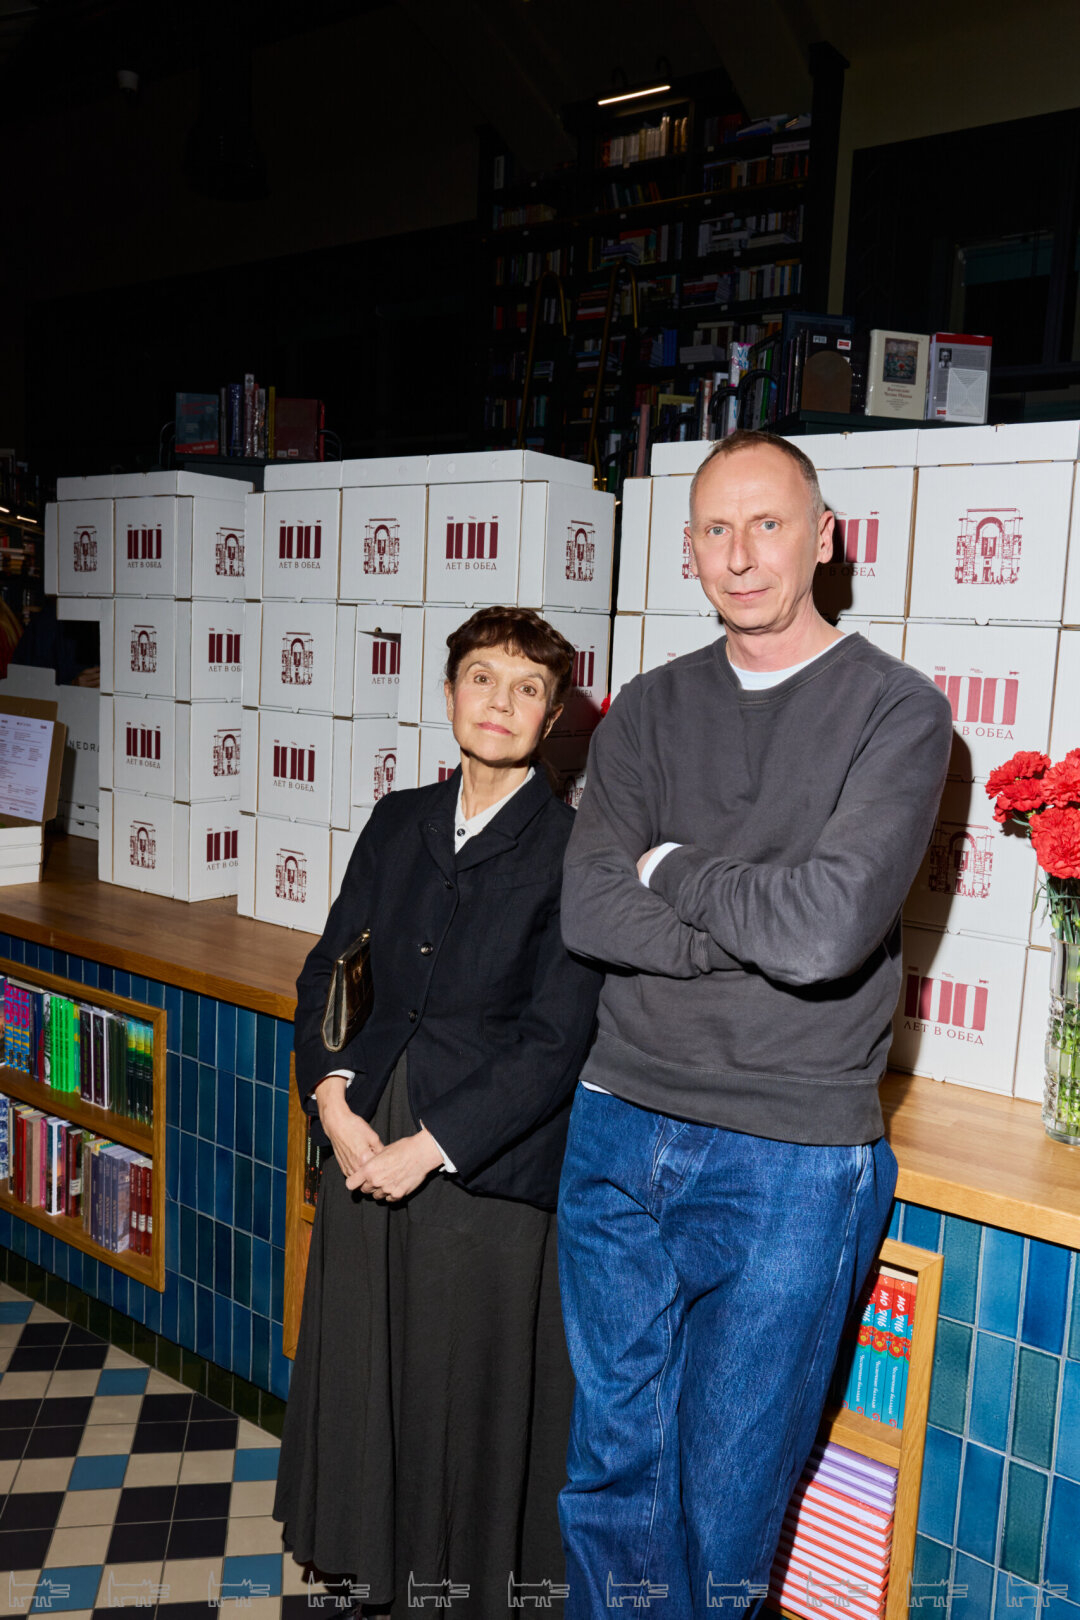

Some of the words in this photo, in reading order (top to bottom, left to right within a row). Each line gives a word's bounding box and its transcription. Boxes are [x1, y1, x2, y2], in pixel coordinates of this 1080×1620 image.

[445, 562, 463, 570] ЛЕТ
[464, 562, 471, 570] В
[472, 562, 497, 571] ОБЕД
[962, 725, 970, 735] В
[975, 726, 1014, 741] ОБЕД
[273, 780, 287, 788] ЛЕТ
[288, 781, 293, 789] В
[294, 782, 315, 792] ОБЕД
[207, 830, 238, 862] 10
[228, 860, 238, 868] ОБ
[903, 1020, 929, 1033] ЛЕТ
[934, 1026, 942, 1036] В
[946, 1028, 984, 1046] ОБЕД
